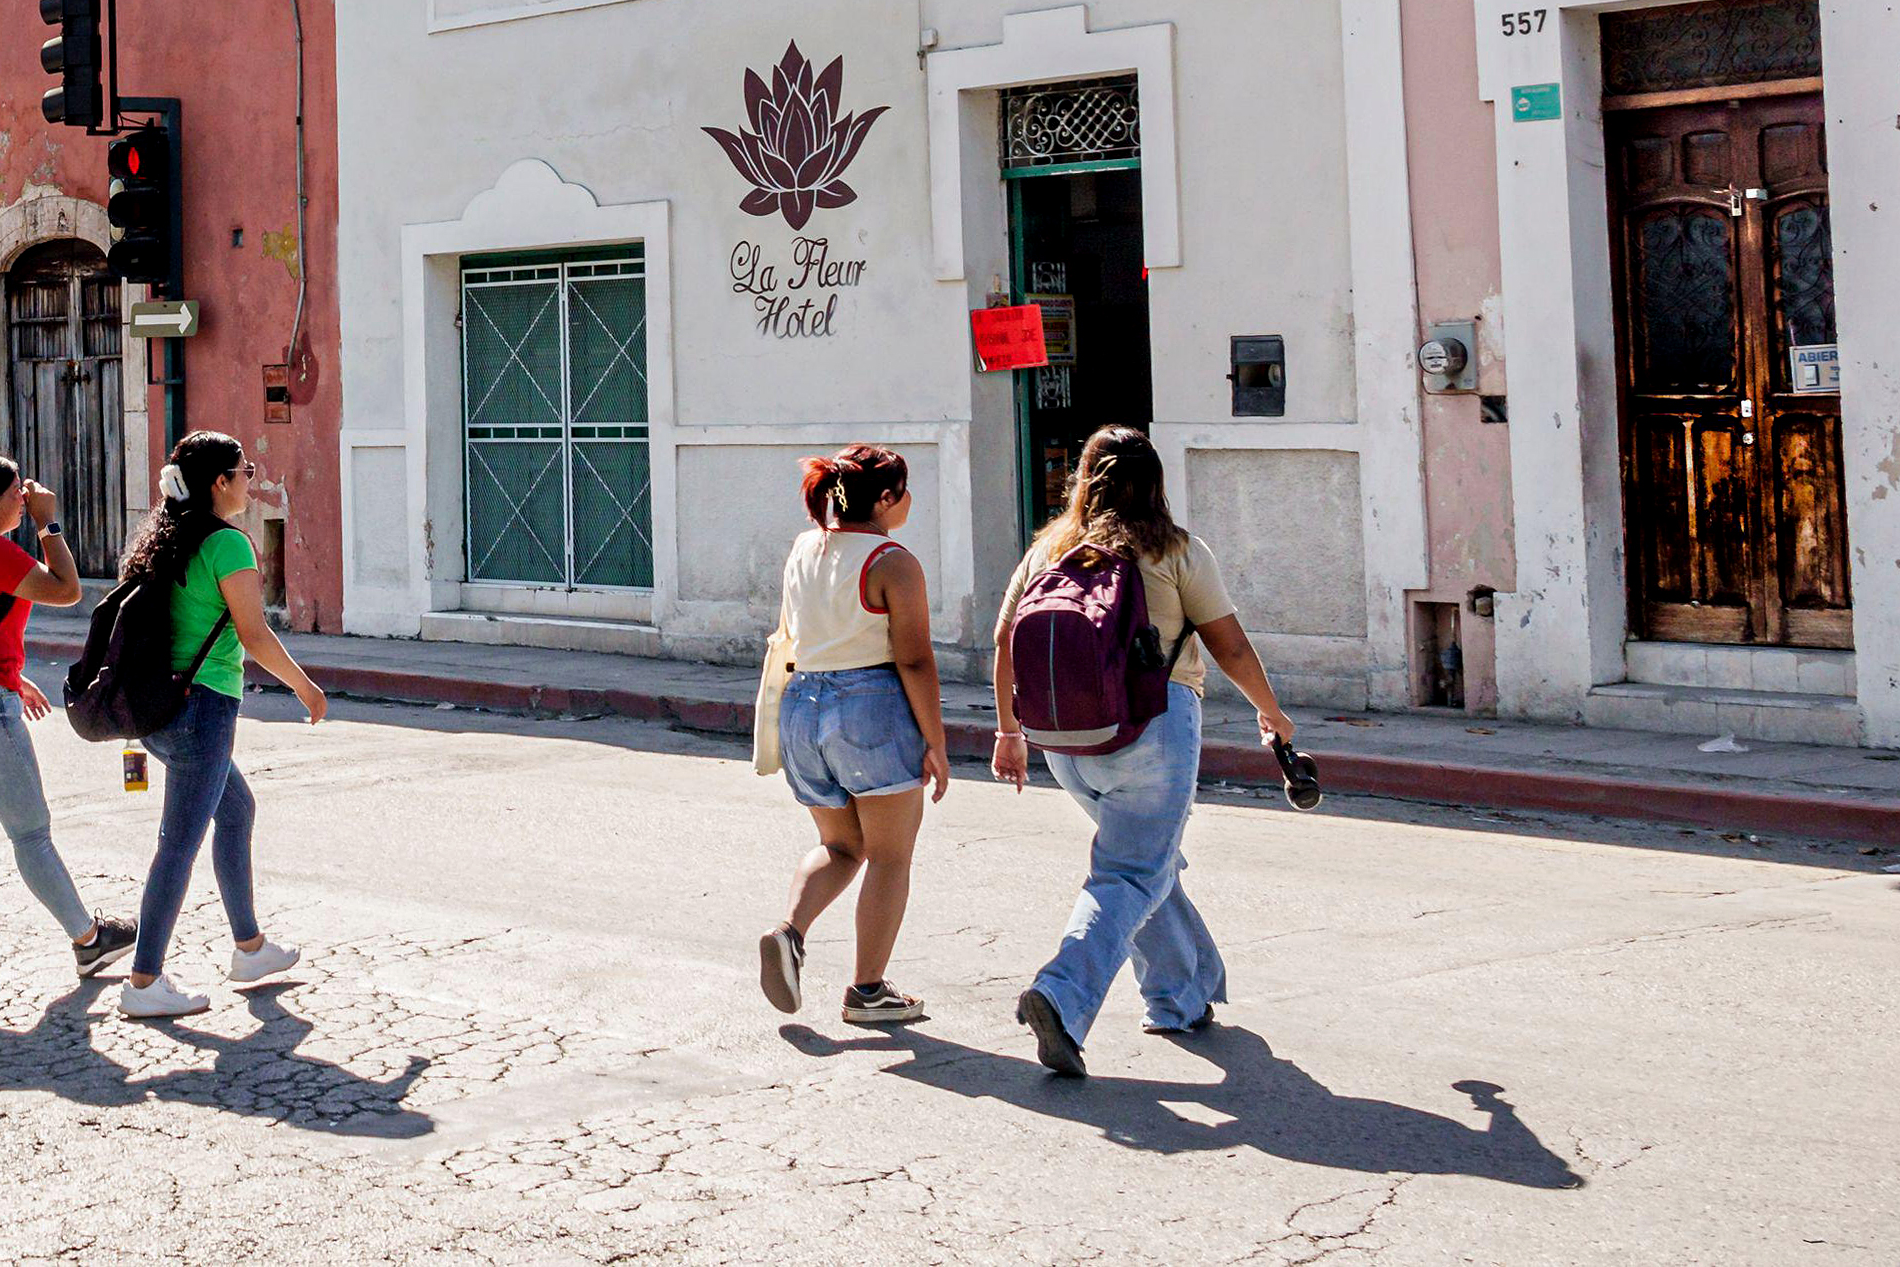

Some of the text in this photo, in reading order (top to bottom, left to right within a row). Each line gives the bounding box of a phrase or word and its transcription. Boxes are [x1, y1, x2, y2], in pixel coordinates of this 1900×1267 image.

[1501, 9, 1547, 37] 557
[730, 236, 867, 295] La Fleur
[754, 293, 838, 339] Hotel
